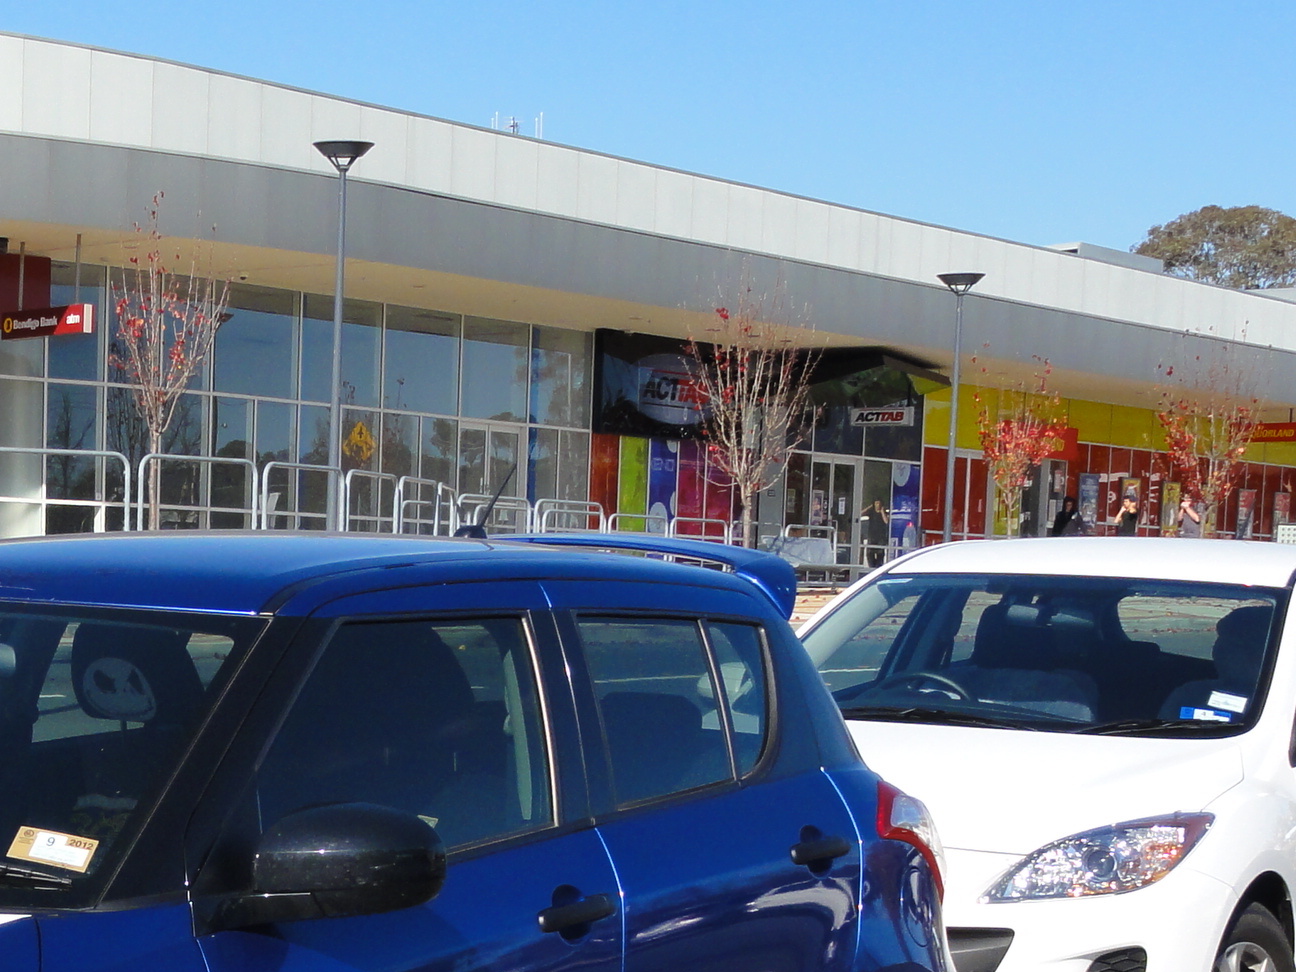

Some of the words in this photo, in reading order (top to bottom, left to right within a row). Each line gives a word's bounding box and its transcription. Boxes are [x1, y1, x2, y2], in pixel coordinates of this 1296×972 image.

[13, 317, 40, 330] Bendigo
[40, 315, 58, 327] Bank
[65, 313, 81, 325] atm
[855, 411, 904, 422] ACTTAB
[46, 836, 56, 847] 9
[69, 838, 94, 851] 2012
